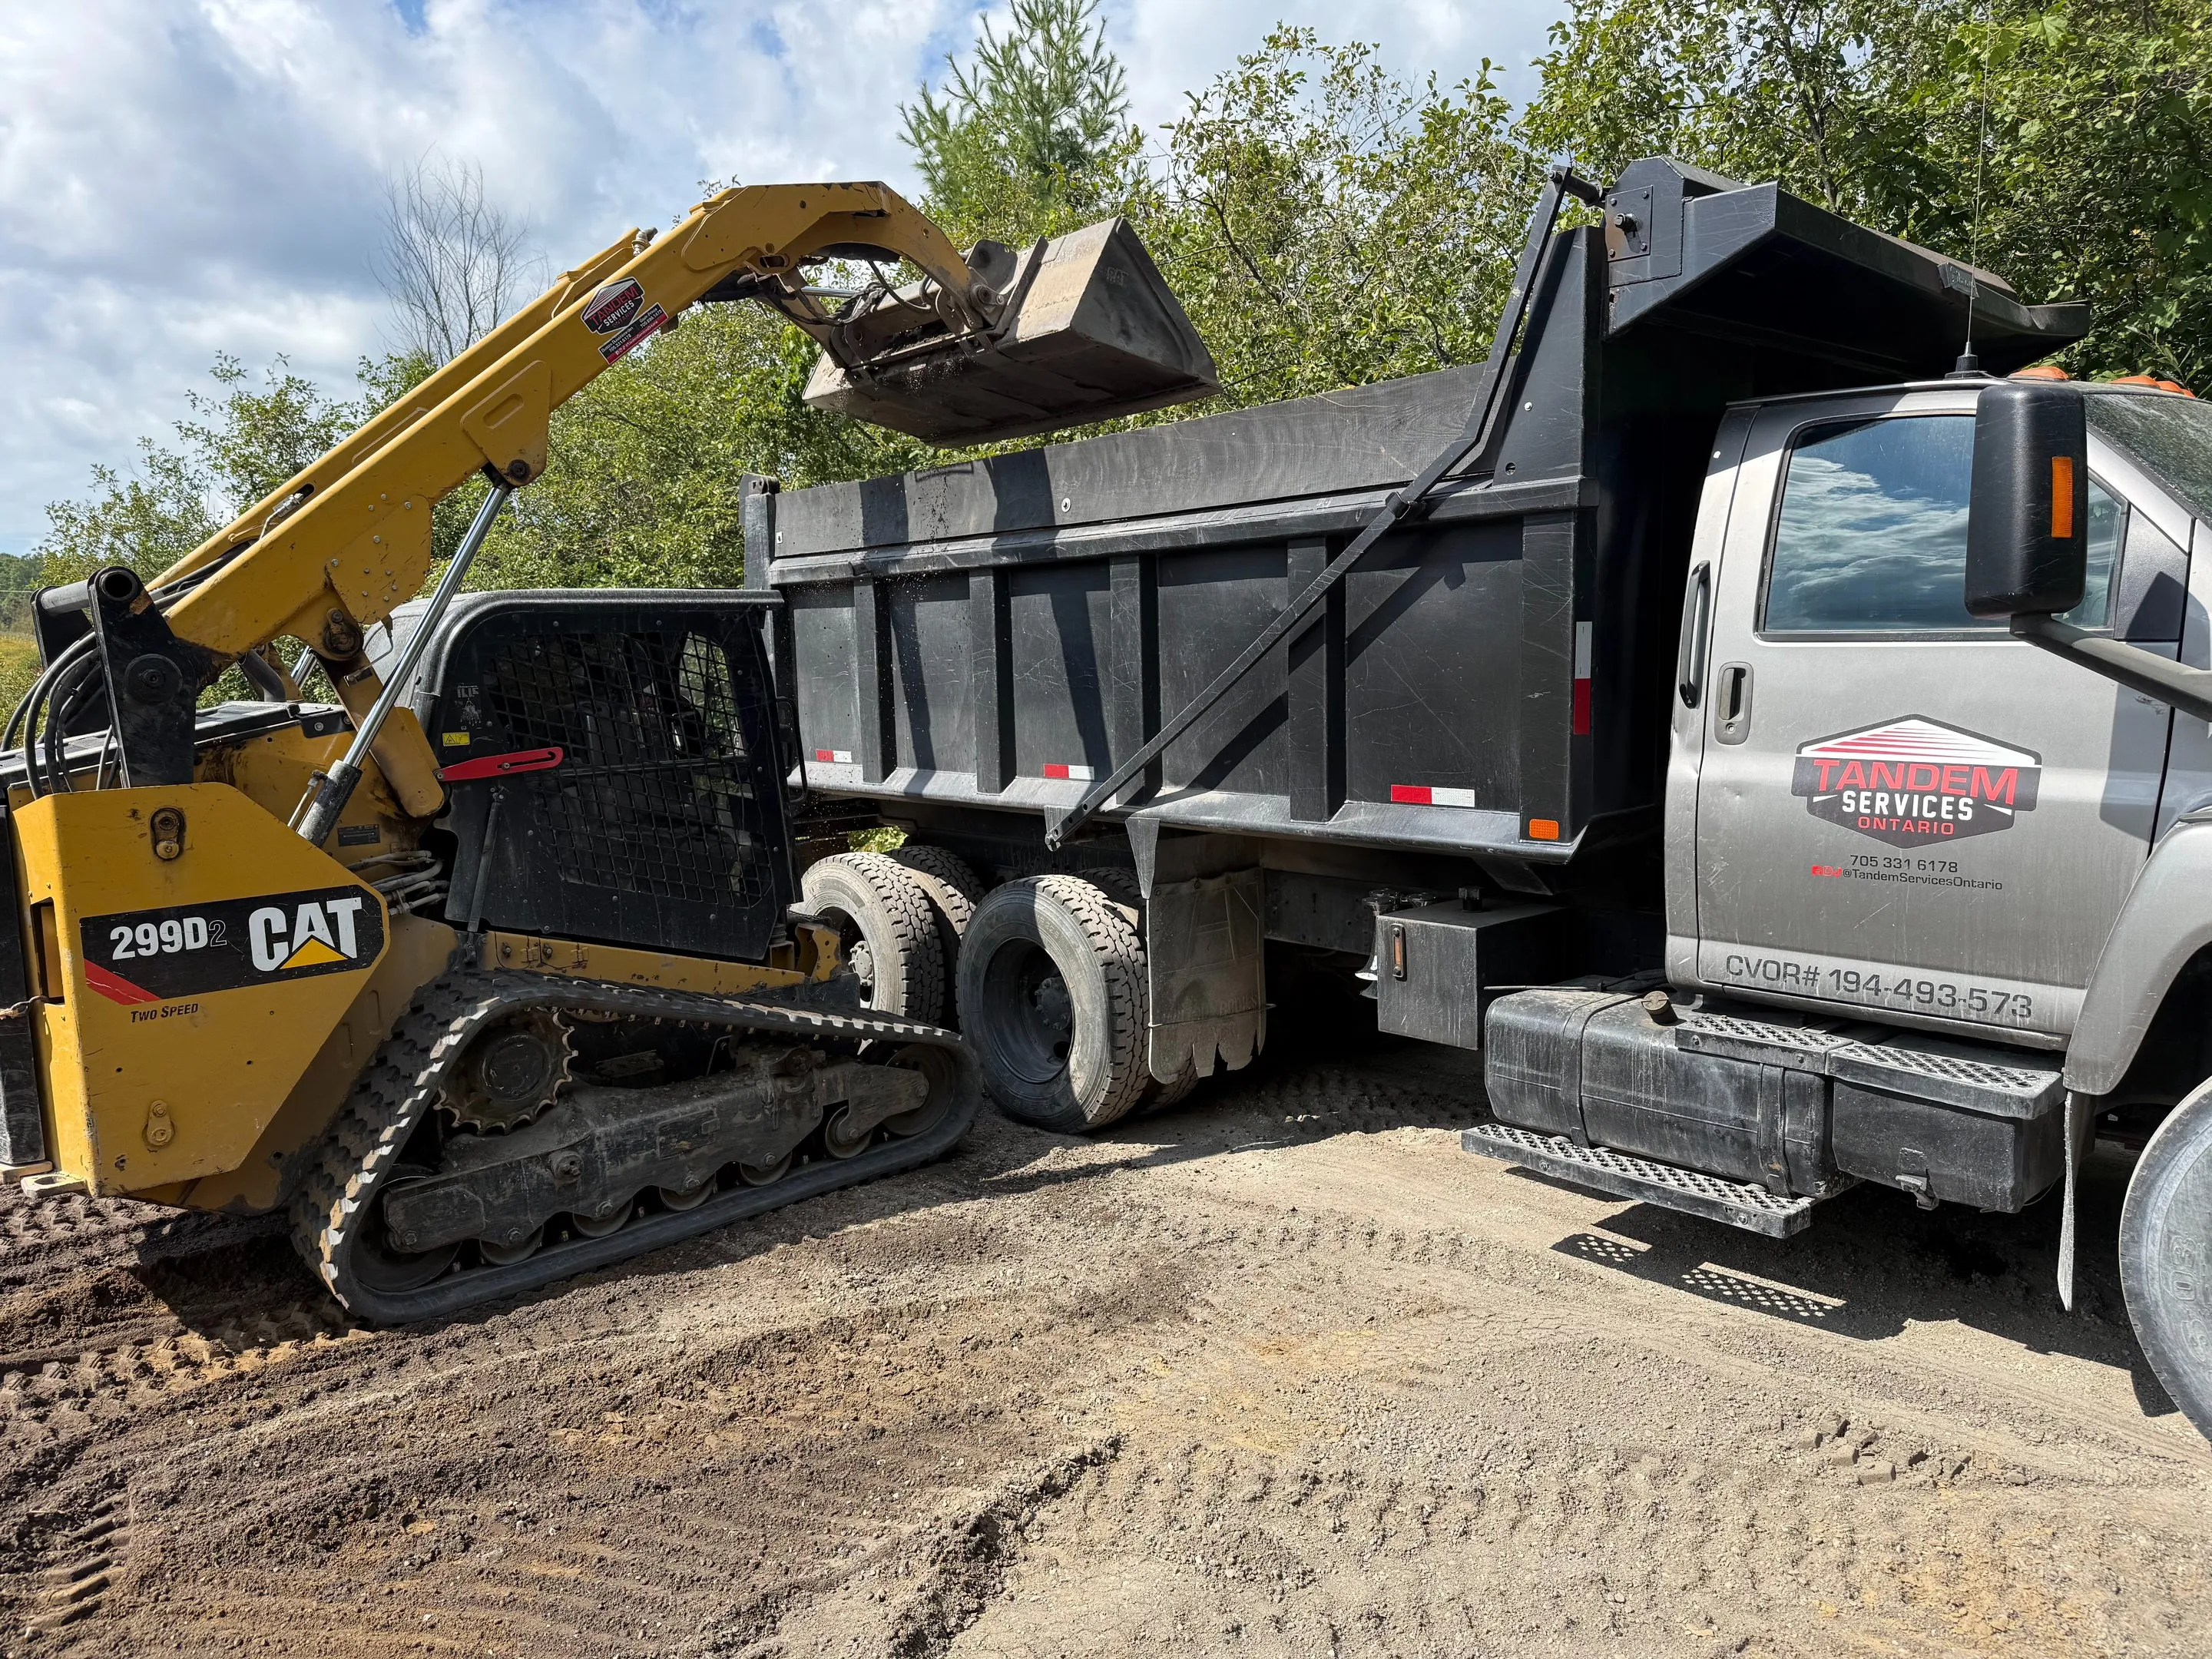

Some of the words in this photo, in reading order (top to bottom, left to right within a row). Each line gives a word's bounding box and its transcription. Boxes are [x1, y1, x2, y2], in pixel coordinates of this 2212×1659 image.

[590, 285, 639, 326] TANDEM
[603, 300, 635, 326] SERVICES
[1813, 759, 2018, 805] TANDEM
[1842, 790, 1973, 821] SERVICES
[1857, 816, 1954, 836] ONTARIO
[1850, 855, 1879, 867] 705
[1883, 857, 1911, 869] 331
[1917, 860, 1959, 873] 6178
[1843, 868, 2003, 890] @TandemServicesOntario
[248, 896, 362, 972] CAT
[1725, 954, 1820, 988] CVOR#
[1828, 969, 2033, 1019] 194-493-573
[131, 1008, 157, 1023] TWO
[161, 1002, 199, 1018] SPEED
